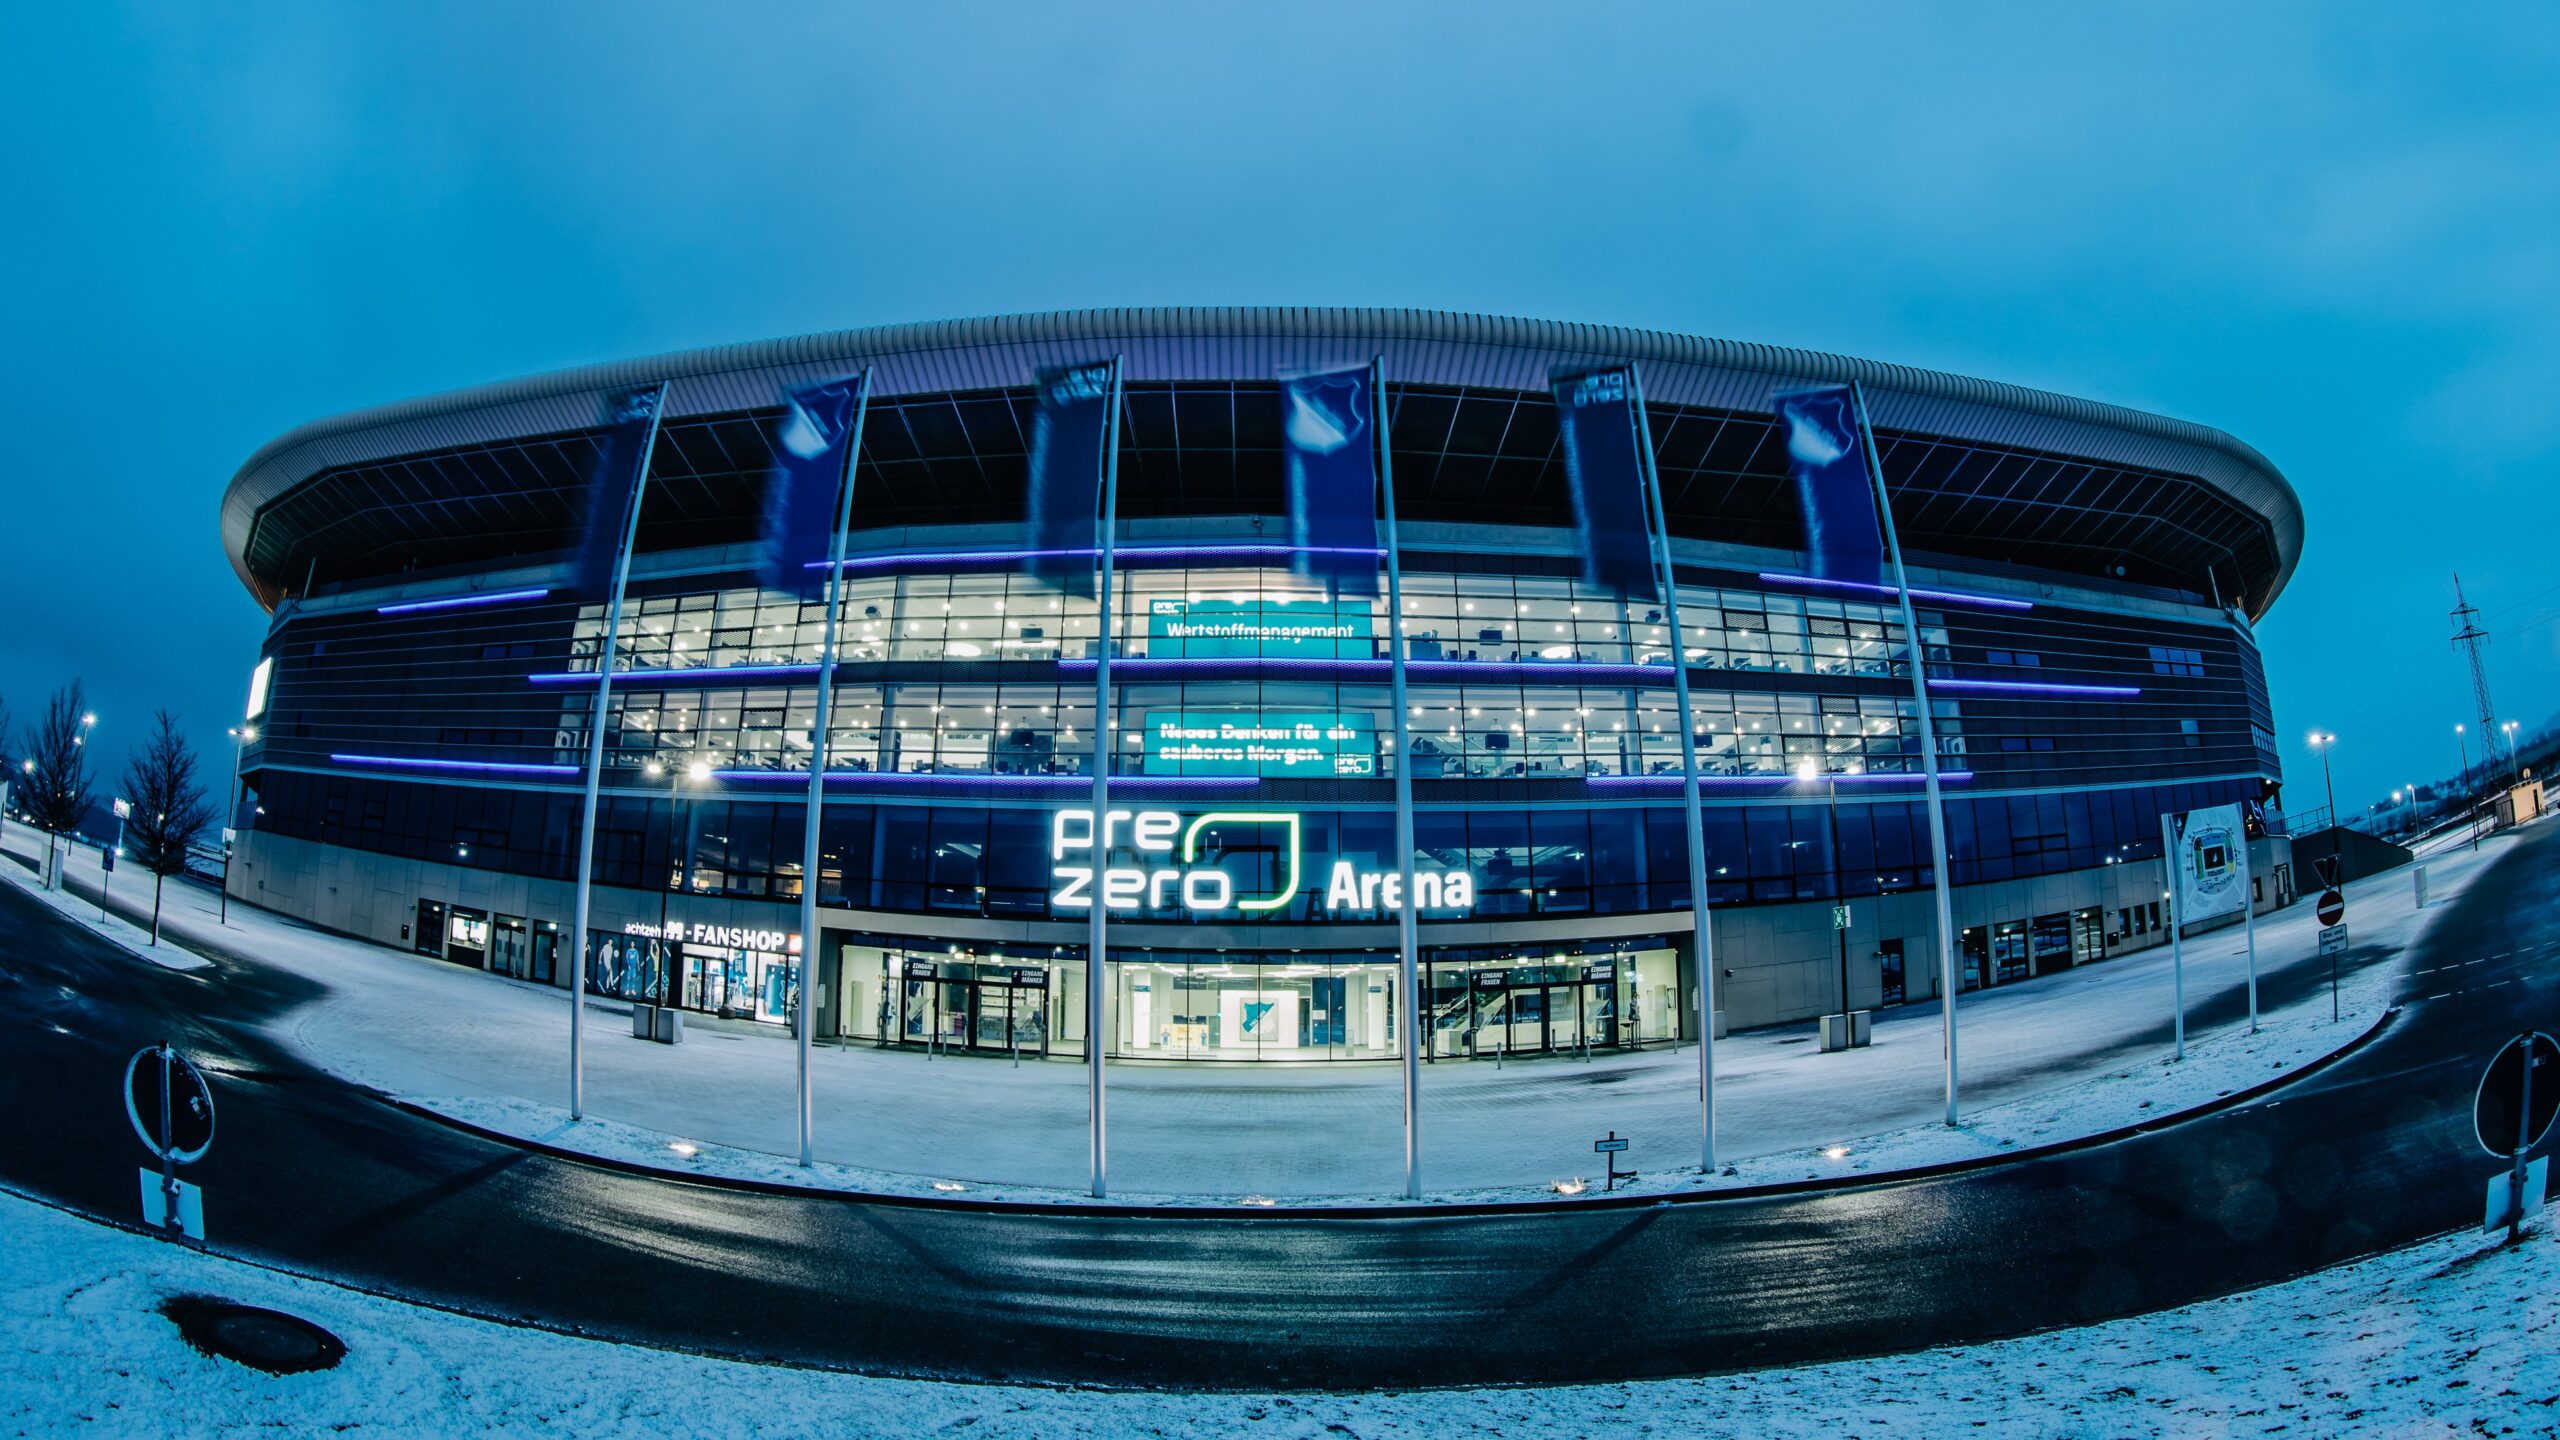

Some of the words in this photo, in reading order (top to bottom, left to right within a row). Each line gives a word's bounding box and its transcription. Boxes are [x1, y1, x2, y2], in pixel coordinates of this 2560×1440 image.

[1166, 622, 1354, 644] Wertstoffmanagement
[1159, 743, 1245, 761] sauberes
[1246, 744, 1324, 766] Morgen.
[1053, 809, 1181, 861] pre
[1052, 867, 1231, 909] zero
[1326, 861, 1473, 909] Arena
[693, 924, 786, 951] FANSHOP
[912, 962, 934, 970] EINGANG
